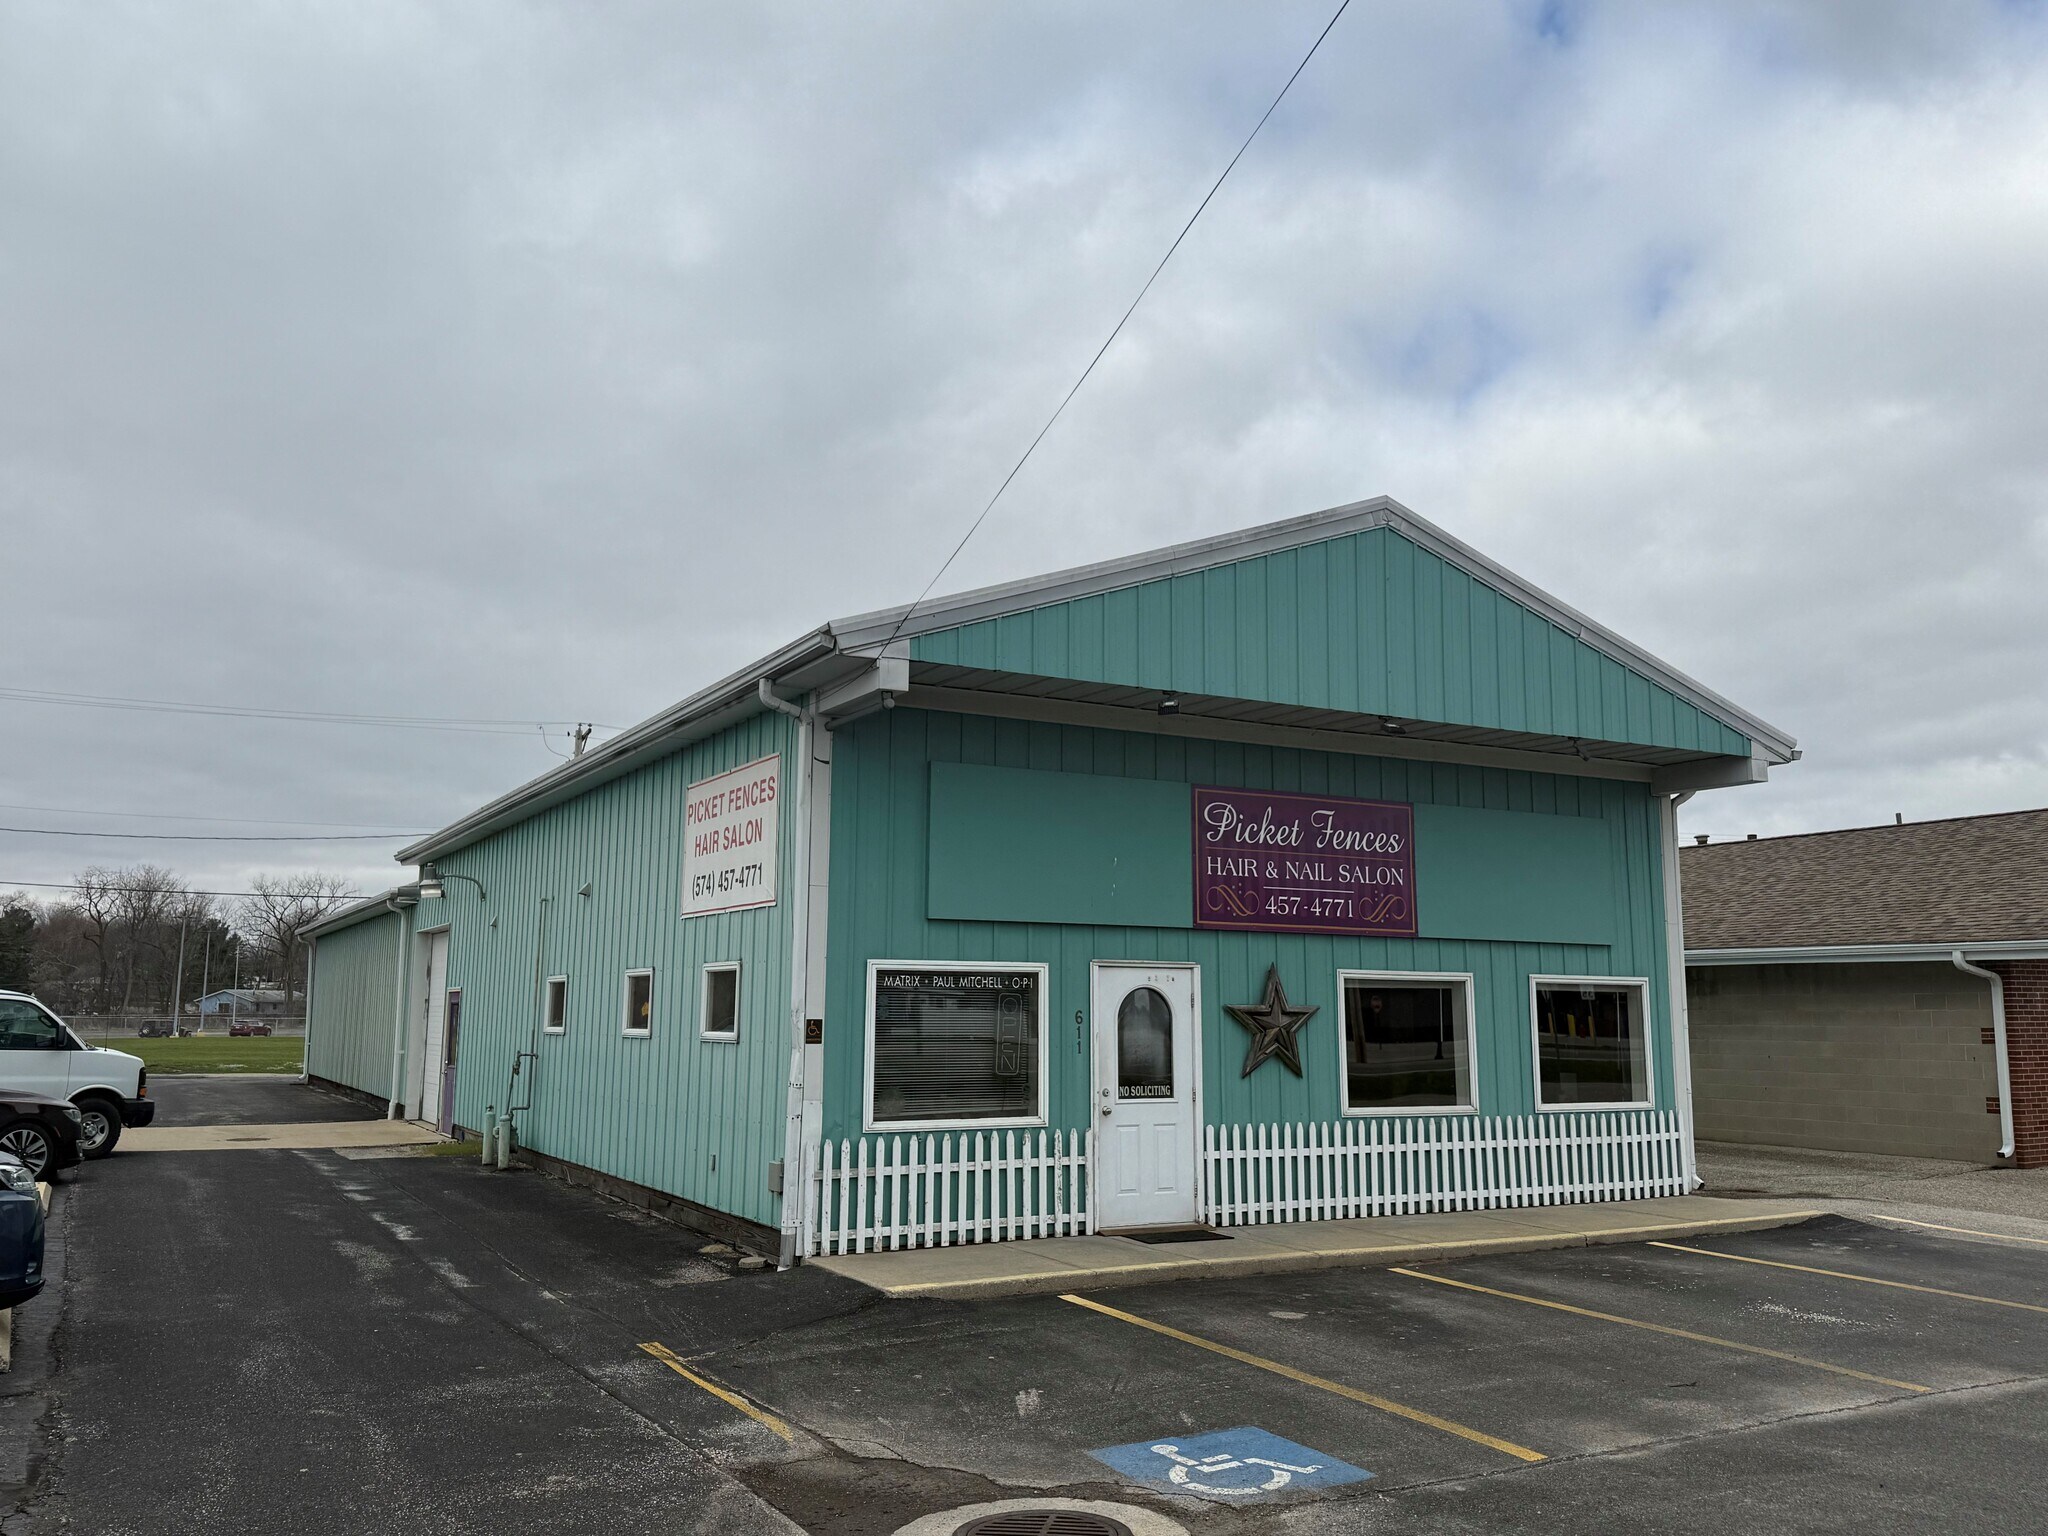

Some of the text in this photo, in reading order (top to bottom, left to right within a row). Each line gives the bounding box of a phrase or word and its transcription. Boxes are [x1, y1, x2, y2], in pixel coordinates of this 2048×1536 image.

[687, 775, 776, 826] PICKET FENCES
[694, 817, 763, 858] HAIR SALON
[1203, 801, 1405, 853] Picket Fences
[692, 862, 763, 900] (574) 457-4771
[1207, 856, 1404, 886] HAIR & NAIL SALON
[1265, 896, 1354, 918] 457-4771
[883, 975, 920, 987] MATRIX
[932, 975, 955, 988] PAUL
[958, 976, 1002, 989] MITCHELL
[1119, 1085, 1171, 1097] NO SOLICITING
